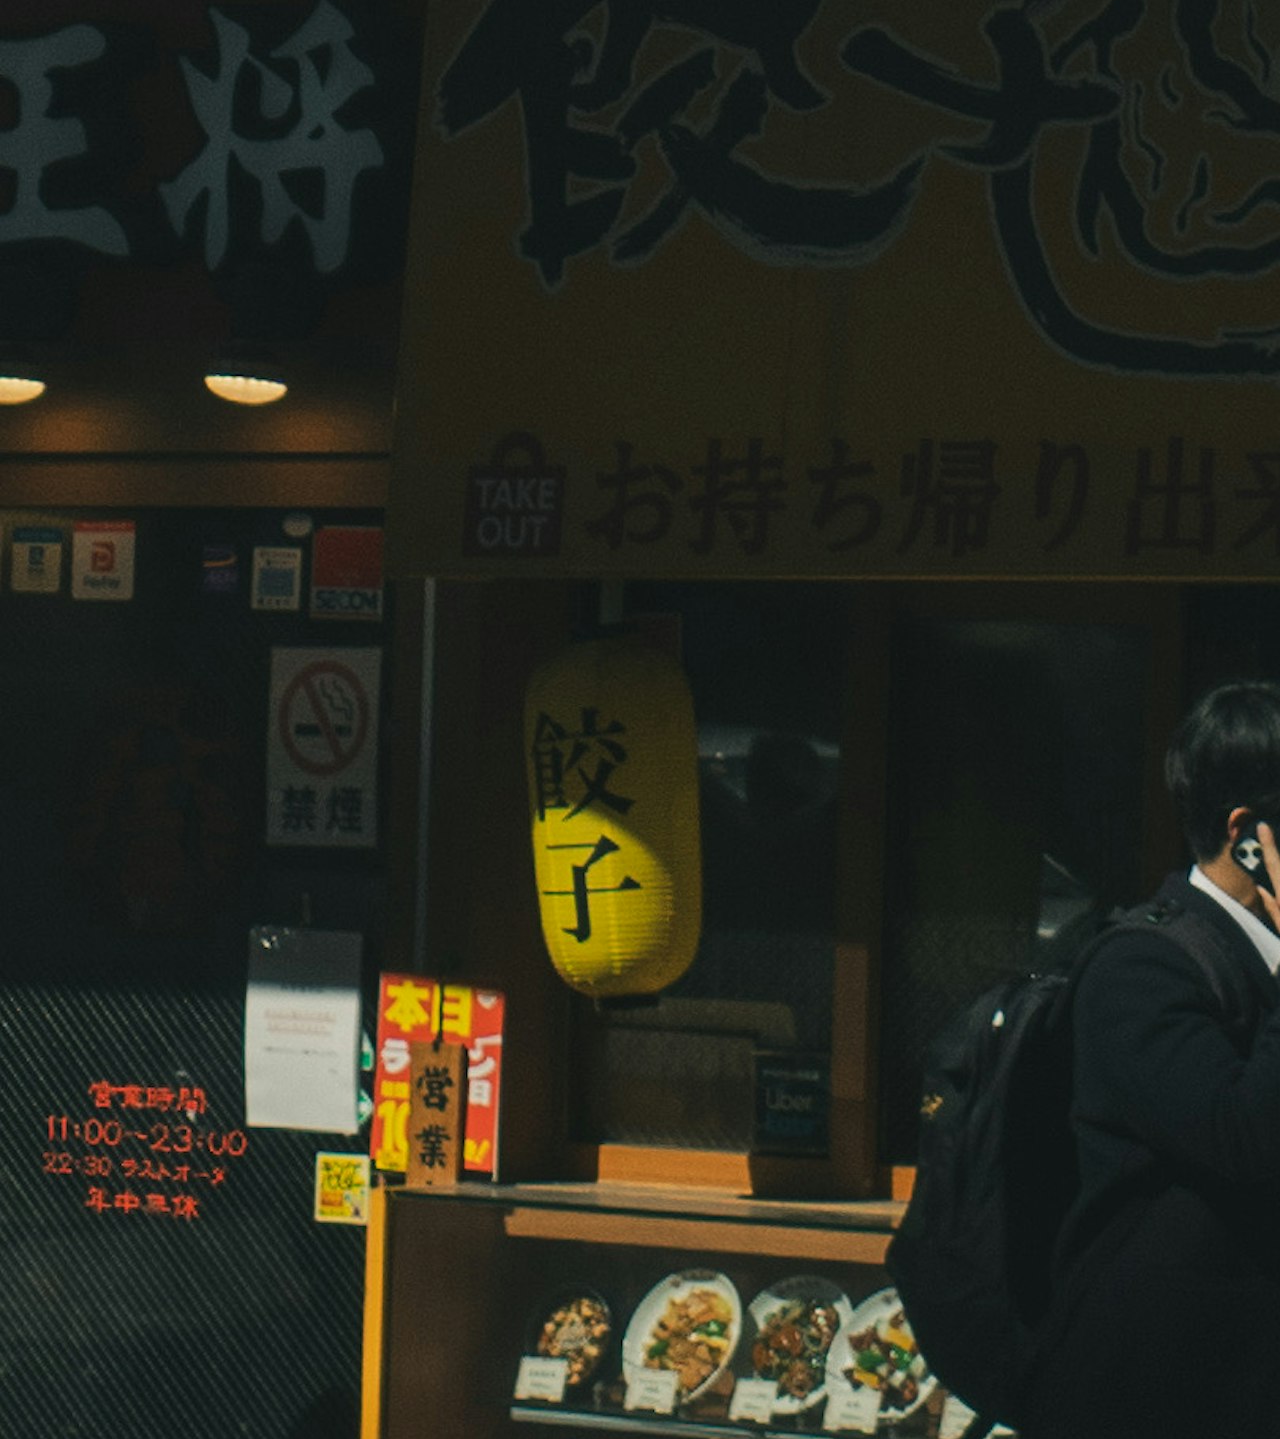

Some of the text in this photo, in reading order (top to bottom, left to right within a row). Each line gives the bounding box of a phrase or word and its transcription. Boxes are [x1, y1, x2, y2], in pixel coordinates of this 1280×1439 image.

[0, 0, 384, 273] 王将
[475, 477, 557, 511] TAKE
[475, 517, 549, 549] OUT
[282, 785, 364, 833] 禁煙
[533, 706, 643, 943] 餃子
[415, 1066, 452, 1169] 営業
